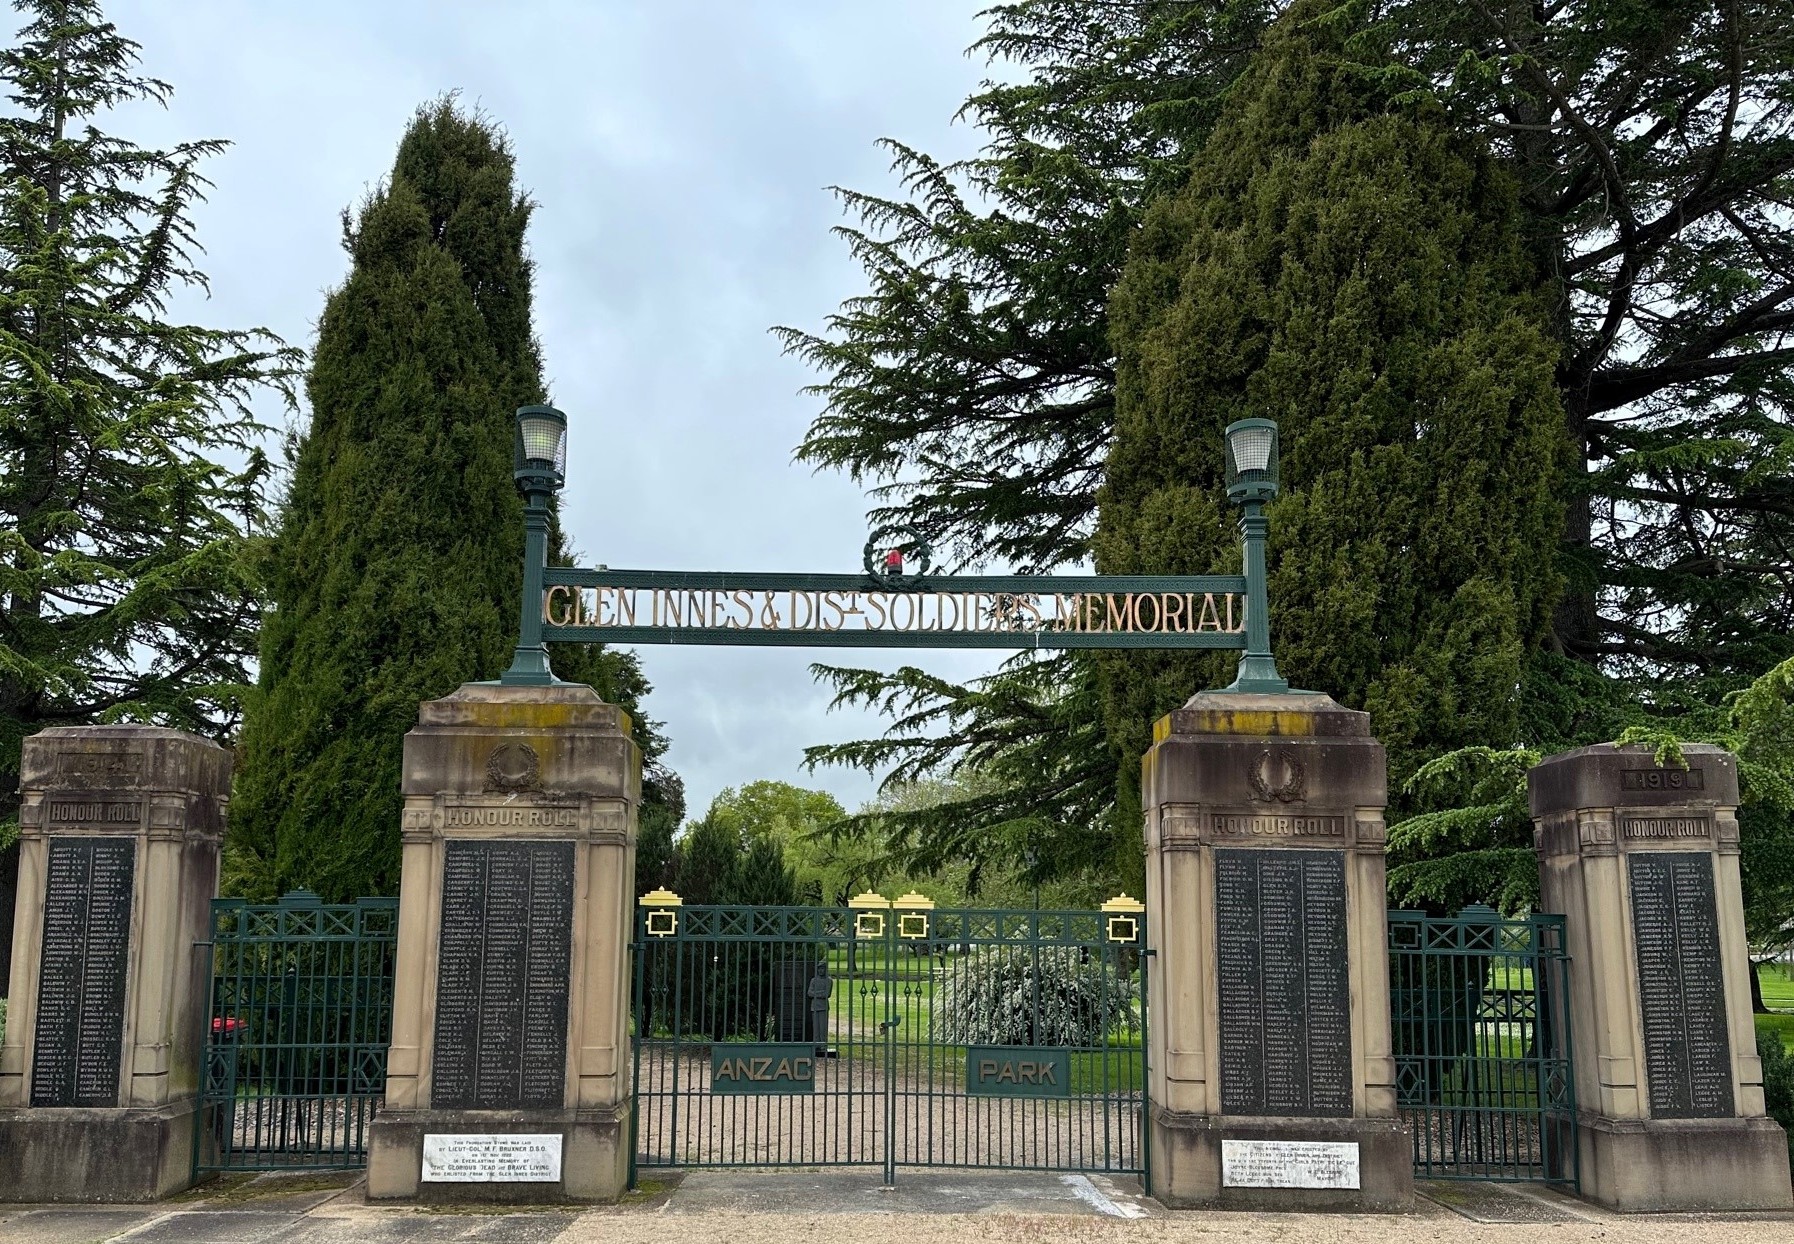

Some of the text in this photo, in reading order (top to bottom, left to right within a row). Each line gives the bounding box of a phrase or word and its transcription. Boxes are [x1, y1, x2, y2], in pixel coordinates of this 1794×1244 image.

[546, 585, 636, 627] GLEN
[652, 587, 753, 630] INNES
[761, 589, 781, 631] &
[865, 591, 1041, 632] SOLDIERS
[1053, 592, 1245, 634] MEMORIAL
[1639, 771, 1682, 788] 1919
[51, 802, 141, 822] HONOUR ROLL
[448, 808, 577, 827] HONOUR ROLL
[1214, 816, 1342, 836] HONOUR ROLL
[1624, 820, 1709, 837] HONOUR ROLL
[714, 1057, 812, 1082] ANZAC
[978, 1059, 1057, 1085] PARK
